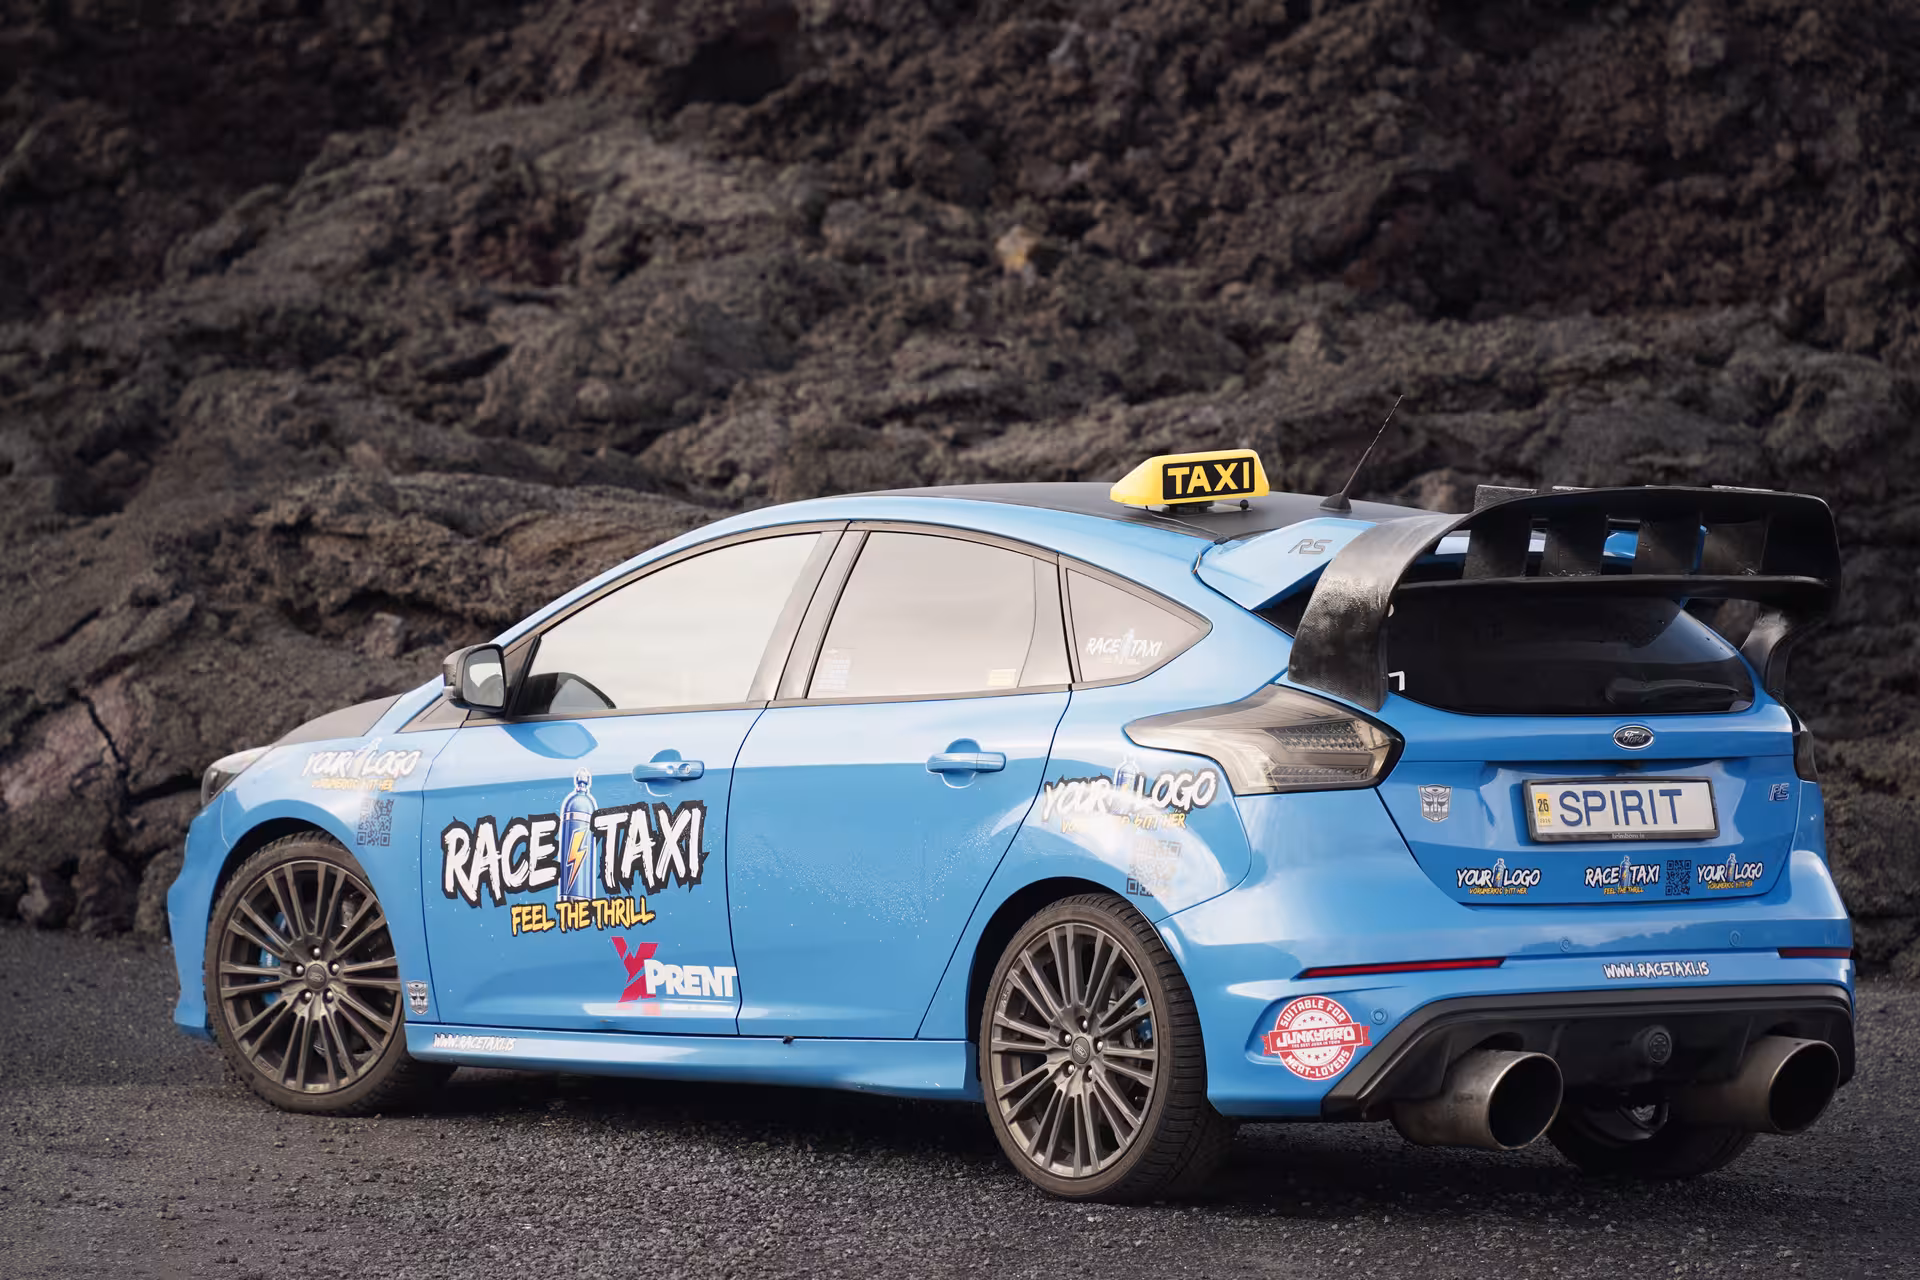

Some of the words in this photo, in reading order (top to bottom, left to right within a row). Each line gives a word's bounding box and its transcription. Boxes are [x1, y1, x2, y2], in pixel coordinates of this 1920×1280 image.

[1167, 461, 1250, 495] TAXI
[1288, 538, 1333, 554] RS
[1086, 637, 1121, 656] RACE
[1131, 639, 1162, 657] TAXI
[302, 750, 354, 778] YOUR
[361, 749, 422, 778] LOGO
[1042, 775, 1114, 821] YOUR
[1137, 768, 1219, 811] LOGO
[1537, 798, 1549, 812] 26
[1559, 789, 1682, 827] SPIRIT
[442, 815, 559, 906] RACE
[592, 802, 706, 892] TAXI
[1456, 868, 1493, 888] YOUR
[1503, 868, 1542, 888] LOGO
[1584, 865, 1620, 888] RACE
[1629, 864, 1661, 885] TAXI
[1697, 864, 1726, 883] YOUR
[1734, 862, 1765, 881] LOGO
[1604, 887, 1617, 895] FEEL
[511, 903, 556, 936] FEEL
[556, 899, 591, 932] THE
[591, 897, 655, 929] THRILL
[1603, 961, 1710, 979] WWW.RACETAXI.IS
[1280, 999, 1325, 1028] SUITABLE
[1326, 1002, 1347, 1023] FOR
[433, 1033, 517, 1052] WWW.RACETAXI.IS
[1276, 1026, 1356, 1048] JUNKYARD
[1285, 1049, 1350, 1077] MEAT-LOVERS
